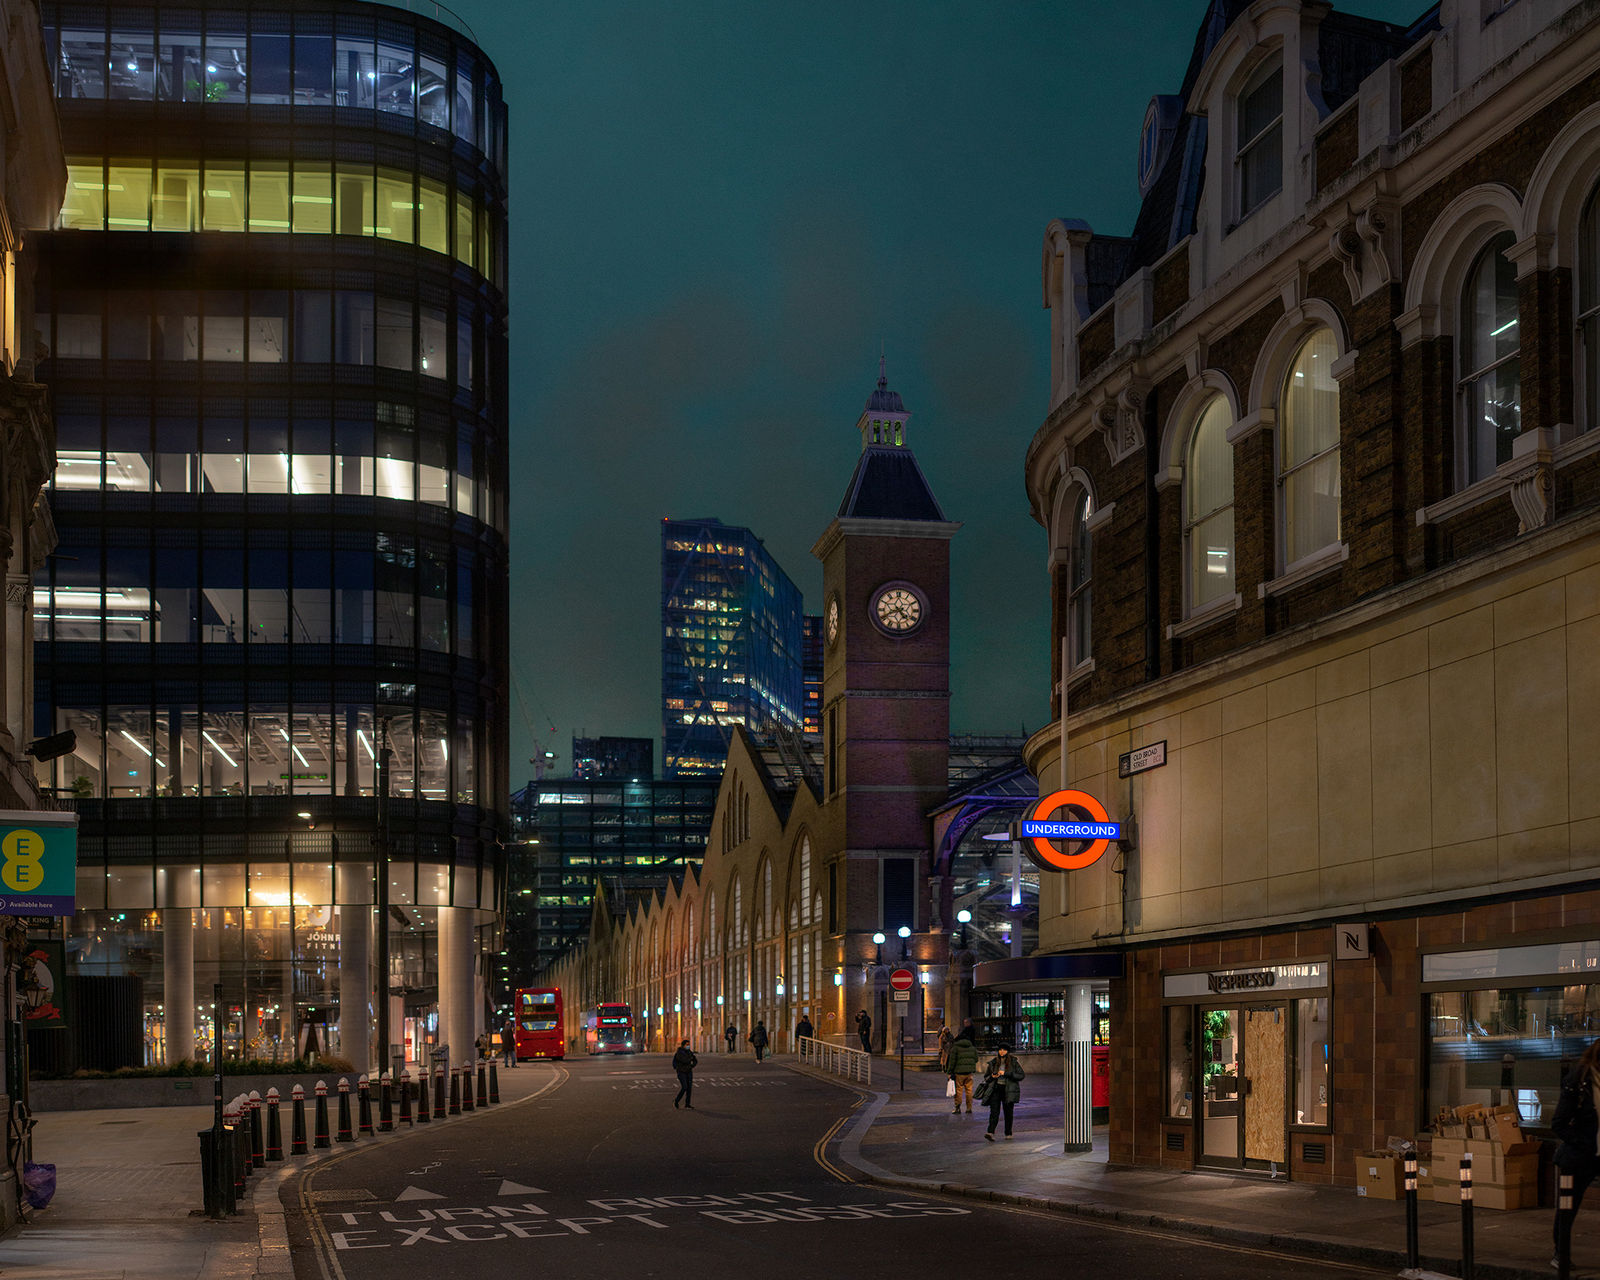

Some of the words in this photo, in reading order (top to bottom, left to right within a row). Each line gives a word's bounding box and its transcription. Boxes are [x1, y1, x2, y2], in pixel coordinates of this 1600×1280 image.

[1133, 753, 1142, 761] OLD
[1143, 748, 1158, 758] BROAD
[1133, 759, 1148, 769] STREET
[1026, 824, 1116, 836] UNDERGROUND
[324, 1203, 550, 1225] TURN
[586, 1191, 813, 1211] RIGHT
[331, 1213, 670, 1250] EXCEPT
[698, 1202, 973, 1225] BUSES
